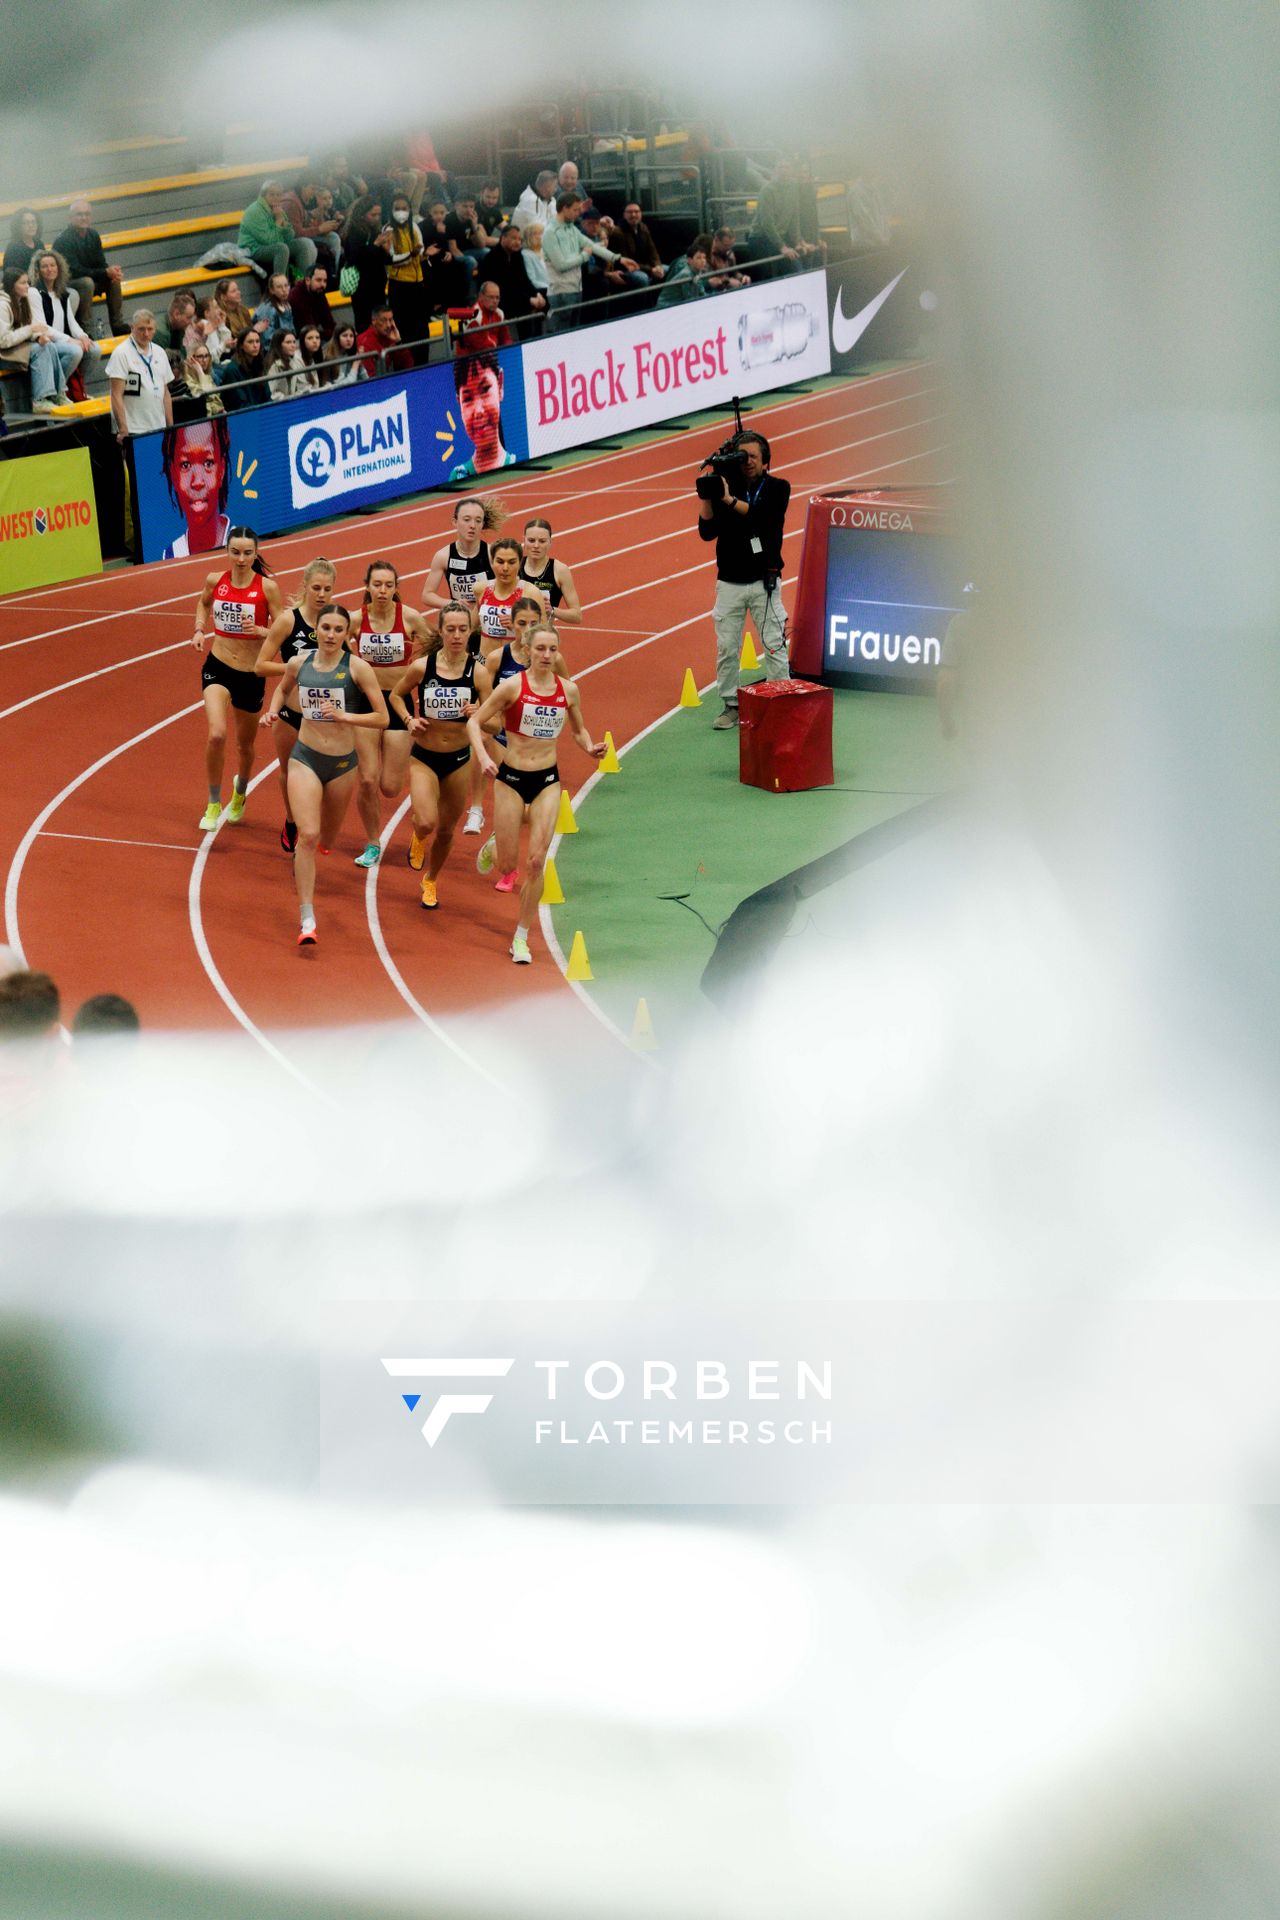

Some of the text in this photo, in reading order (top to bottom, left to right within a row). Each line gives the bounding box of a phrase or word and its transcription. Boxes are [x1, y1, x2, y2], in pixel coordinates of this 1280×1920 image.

[535, 325, 729, 426] Black Forest
[340, 412, 404, 461] PLAN
[343, 453, 405, 479] INTERNATIONAL
[46, 499, 91, 532] LOTTO
[850, 509, 914, 532] OMEGA
[456, 574, 477, 584] GLS
[453, 583, 474, 593] EWE
[221, 602, 243, 613] GLS
[487, 606, 507, 616] GLS
[483, 614, 501, 627] PUL
[370, 634, 392, 644] GLS
[829, 614, 941, 666] Frauen
[307, 688, 331, 698] GLS
[434, 687, 458, 698] GLS
[534, 706, 558, 717] GLS
